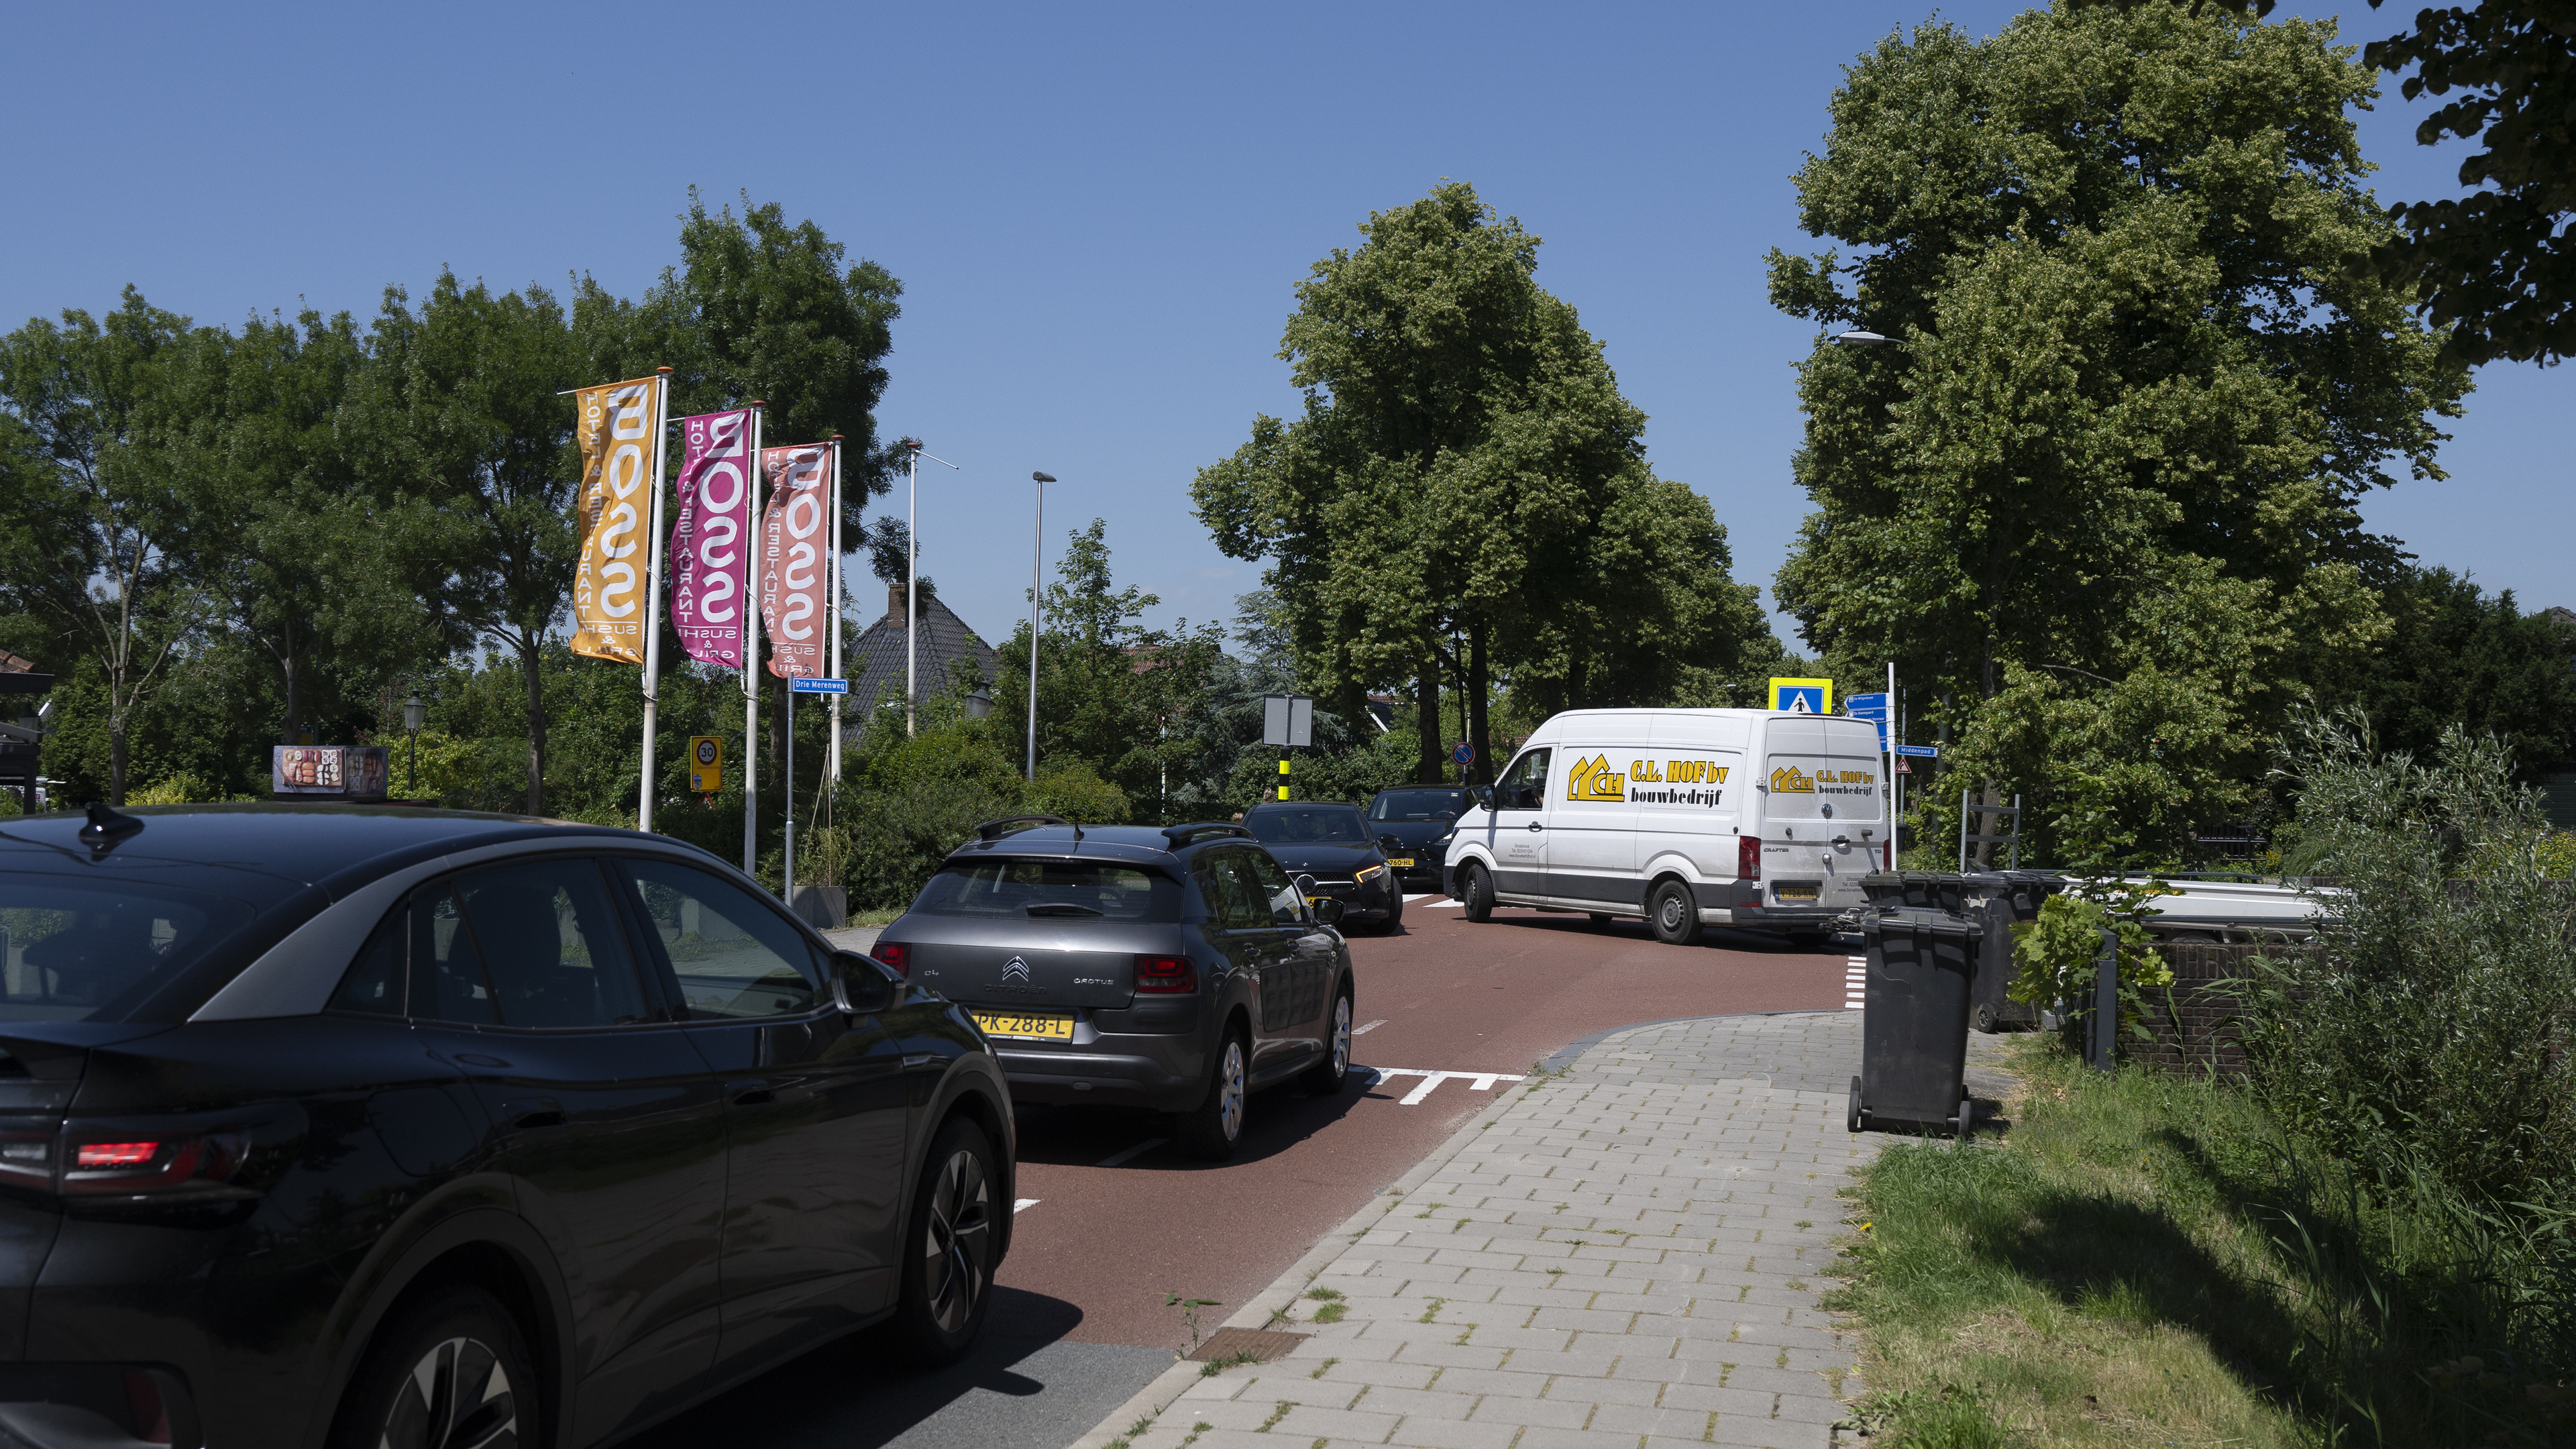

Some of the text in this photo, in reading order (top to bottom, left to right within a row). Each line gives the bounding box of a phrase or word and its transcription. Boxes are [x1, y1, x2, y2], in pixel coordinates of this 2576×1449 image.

[796, 680, 845, 691] Drie Merenweg
[701, 747, 714, 757] 30
[1630, 760, 1730, 784] C.L. HOF bv
[1816, 769, 1838, 783] C.L.
[1840, 770, 1862, 784] HOF
[1631, 787, 1723, 808] bouwbedrijf
[1819, 785, 1872, 797] bouwbedrijf
[1780, 888, 1814, 898] V-726-KN
[977, 1012, 1065, 1034] PK-288-L
